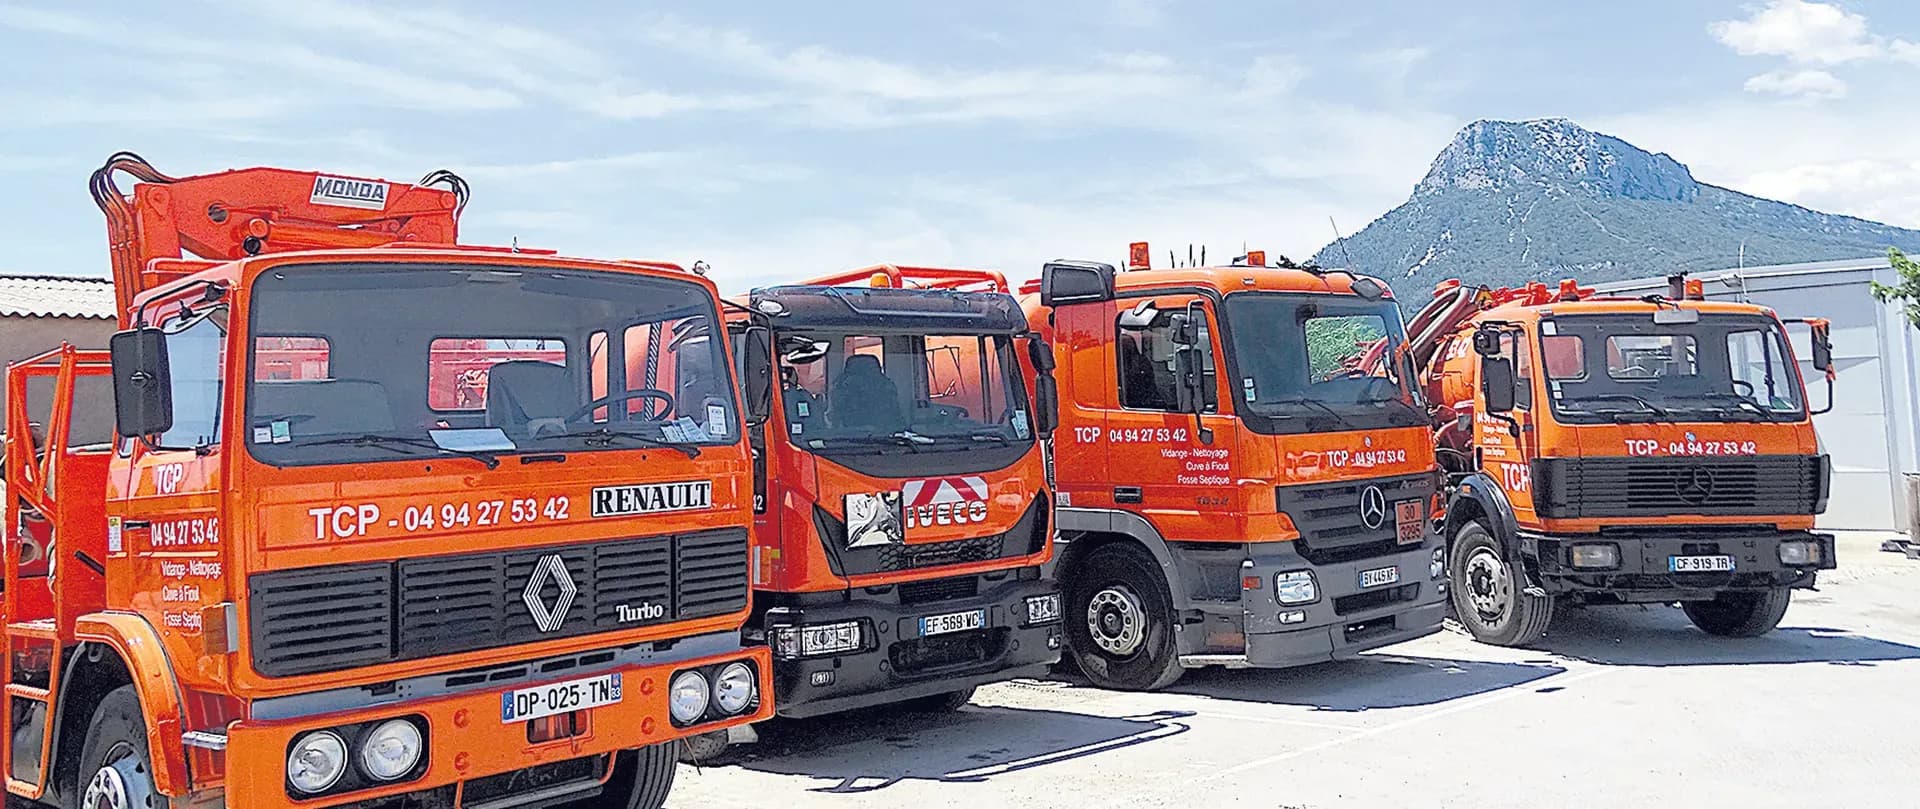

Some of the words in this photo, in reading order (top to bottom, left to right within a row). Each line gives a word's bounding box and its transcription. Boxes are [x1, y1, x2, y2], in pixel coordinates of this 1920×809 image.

[313, 177, 384, 200] MONDA
[1074, 427, 1101, 443] TCP
[1109, 429, 1123, 442] 04
[1125, 429, 1139, 442] 94
[1140, 428, 1154, 442] 27
[1156, 428, 1170, 442] 53
[1173, 428, 1187, 442] 42
[1161, 448, 1188, 459] Vidange
[1193, 447, 1229, 459] Nettoyage
[1625, 440, 1658, 455] TCP
[1669, 442, 1686, 454] 04
[1687, 442, 1704, 454] 94
[1705, 442, 1721, 454] 27
[1723, 442, 1739, 454] 53
[1740, 441, 1756, 454] 42
[1186, 461, 1205, 471] Cuve
[1211, 461, 1230, 470] Fioul
[1327, 450, 1349, 467] TCP
[1355, 452, 1365, 466] 04
[1365, 451, 1376, 465] 94
[1376, 450, 1386, 464] 27
[1387, 450, 1396, 463] 53
[1397, 449, 1406, 462] 42
[156, 463, 183, 496] TCP
[1177, 474, 1199, 485] Fosse
[1199, 474, 1230, 487] Septique
[1501, 462, 1533, 492] TCP
[595, 483, 709, 515] RENAULT
[308, 503, 380, 539] TCP
[404, 505, 435, 532] 04
[441, 502, 471, 529] 94
[477, 500, 505, 526] 27
[511, 498, 538, 523] 53
[543, 496, 569, 520] 42
[906, 500, 987, 529] IVECO
[1404, 504, 1416, 520] 30
[151, 523, 162, 546] 04
[163, 521, 176, 545] 94
[177, 520, 189, 544] 27
[191, 519, 205, 544] 53
[206, 517, 219, 543] 42
[161, 561, 186, 580] Vidange
[189, 560, 221, 579] Nettoyage
[162, 585, 178, 602] Cuve
[184, 585, 199, 602] Fioul
[163, 610, 182, 627] Fosse
[615, 602, 664, 623] Turbo
[517, 679, 609, 717] DP-025-TN
